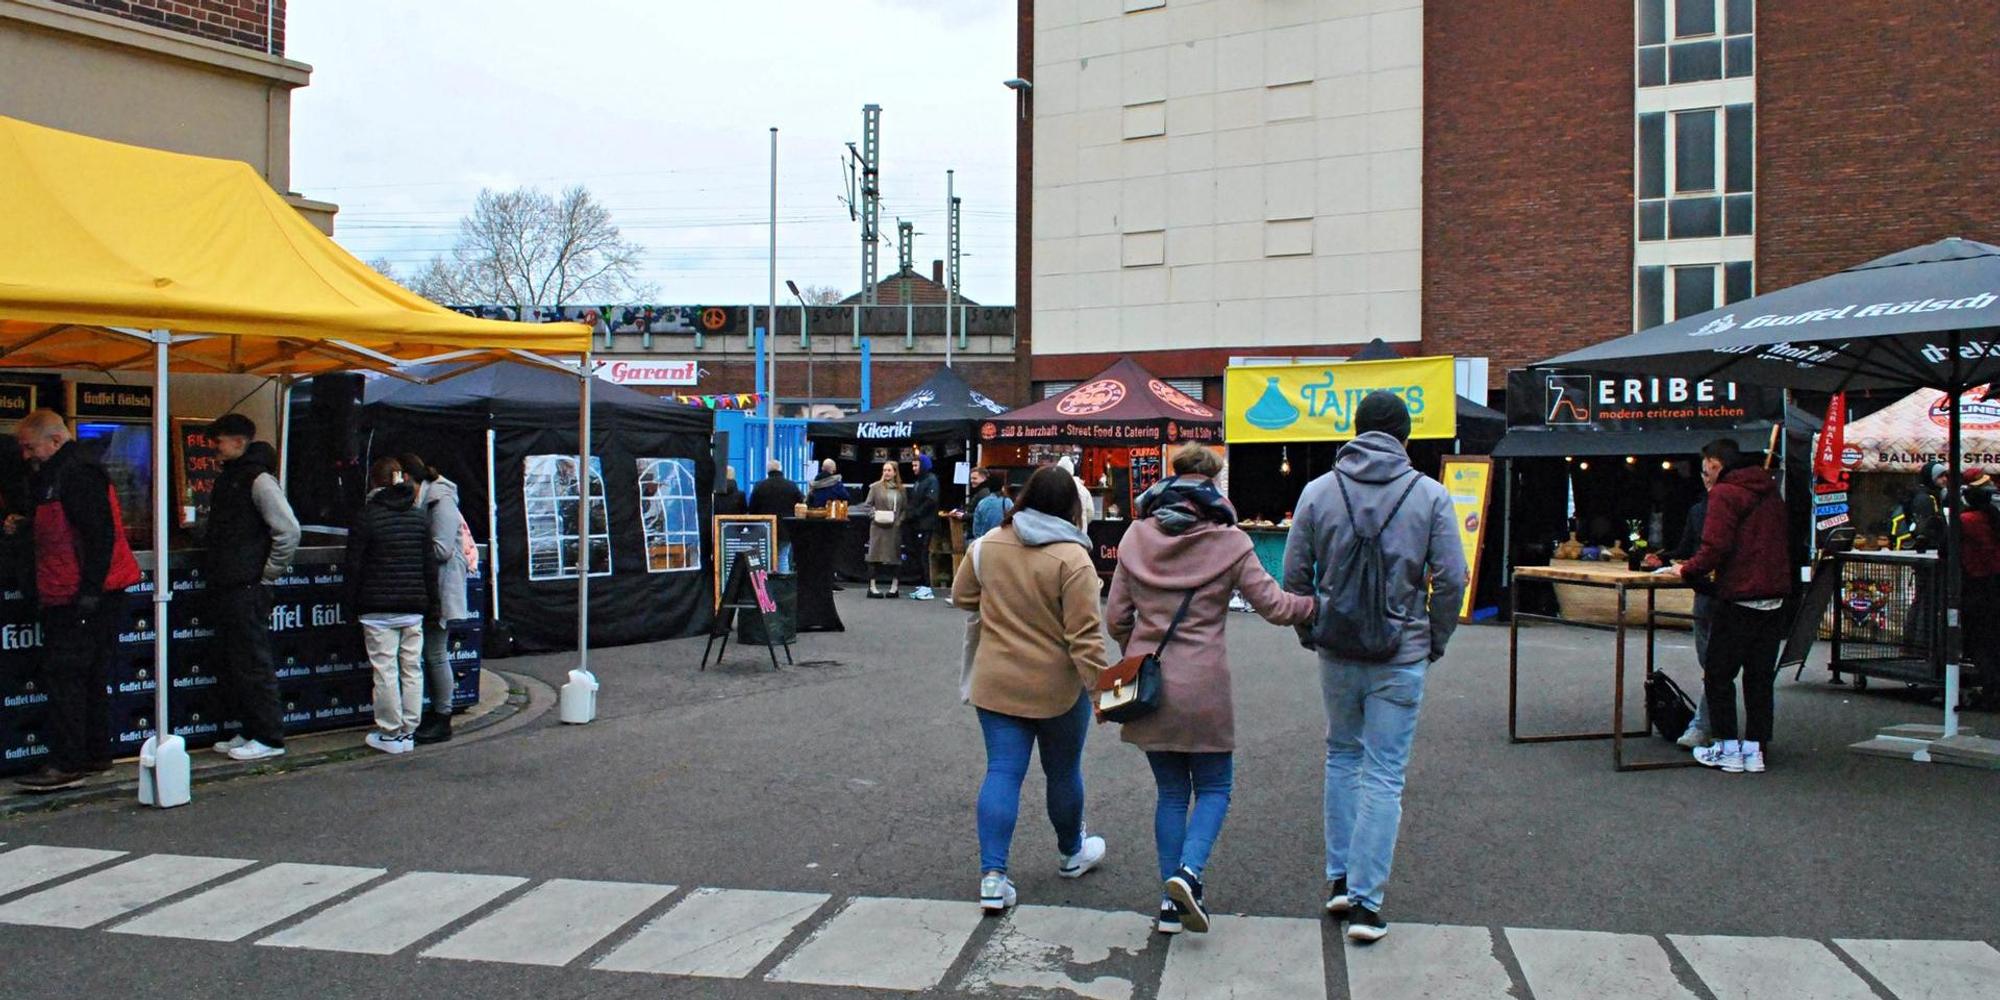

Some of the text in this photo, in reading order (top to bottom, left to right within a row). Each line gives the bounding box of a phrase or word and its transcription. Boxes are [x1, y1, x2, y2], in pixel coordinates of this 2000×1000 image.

[1740, 291, 1999, 330] Gaffel Kölsch
[611, 362, 695, 382] Garant
[0, 396, 25, 409] lsch
[83, 391, 115, 405] Gaffel
[1599, 404, 1745, 420] modern eritrean kitchen
[856, 421, 913, 439] Kikeriki
[1016, 425, 1023, 437] &
[1025, 424, 1058, 438] herzhaft
[1066, 423, 1092, 437] Street
[1093, 425, 1113, 438] Food
[1115, 426, 1122, 438] &
[1124, 426, 1160, 440] Catering
[1823, 425, 1837, 462] MALAM
[1878, 453, 1946, 463] BALINES
[1817, 505, 1844, 514] KUTA
[268, 603, 347, 632] ffel Köl
[2, 621, 43, 650] Köl
[119, 681, 142, 692] Gaffel
[4, 693, 49, 706] Gaffel Köls
[120, 731, 142, 742] Gaffel
[5, 745, 50, 759] Gaffel Köls
